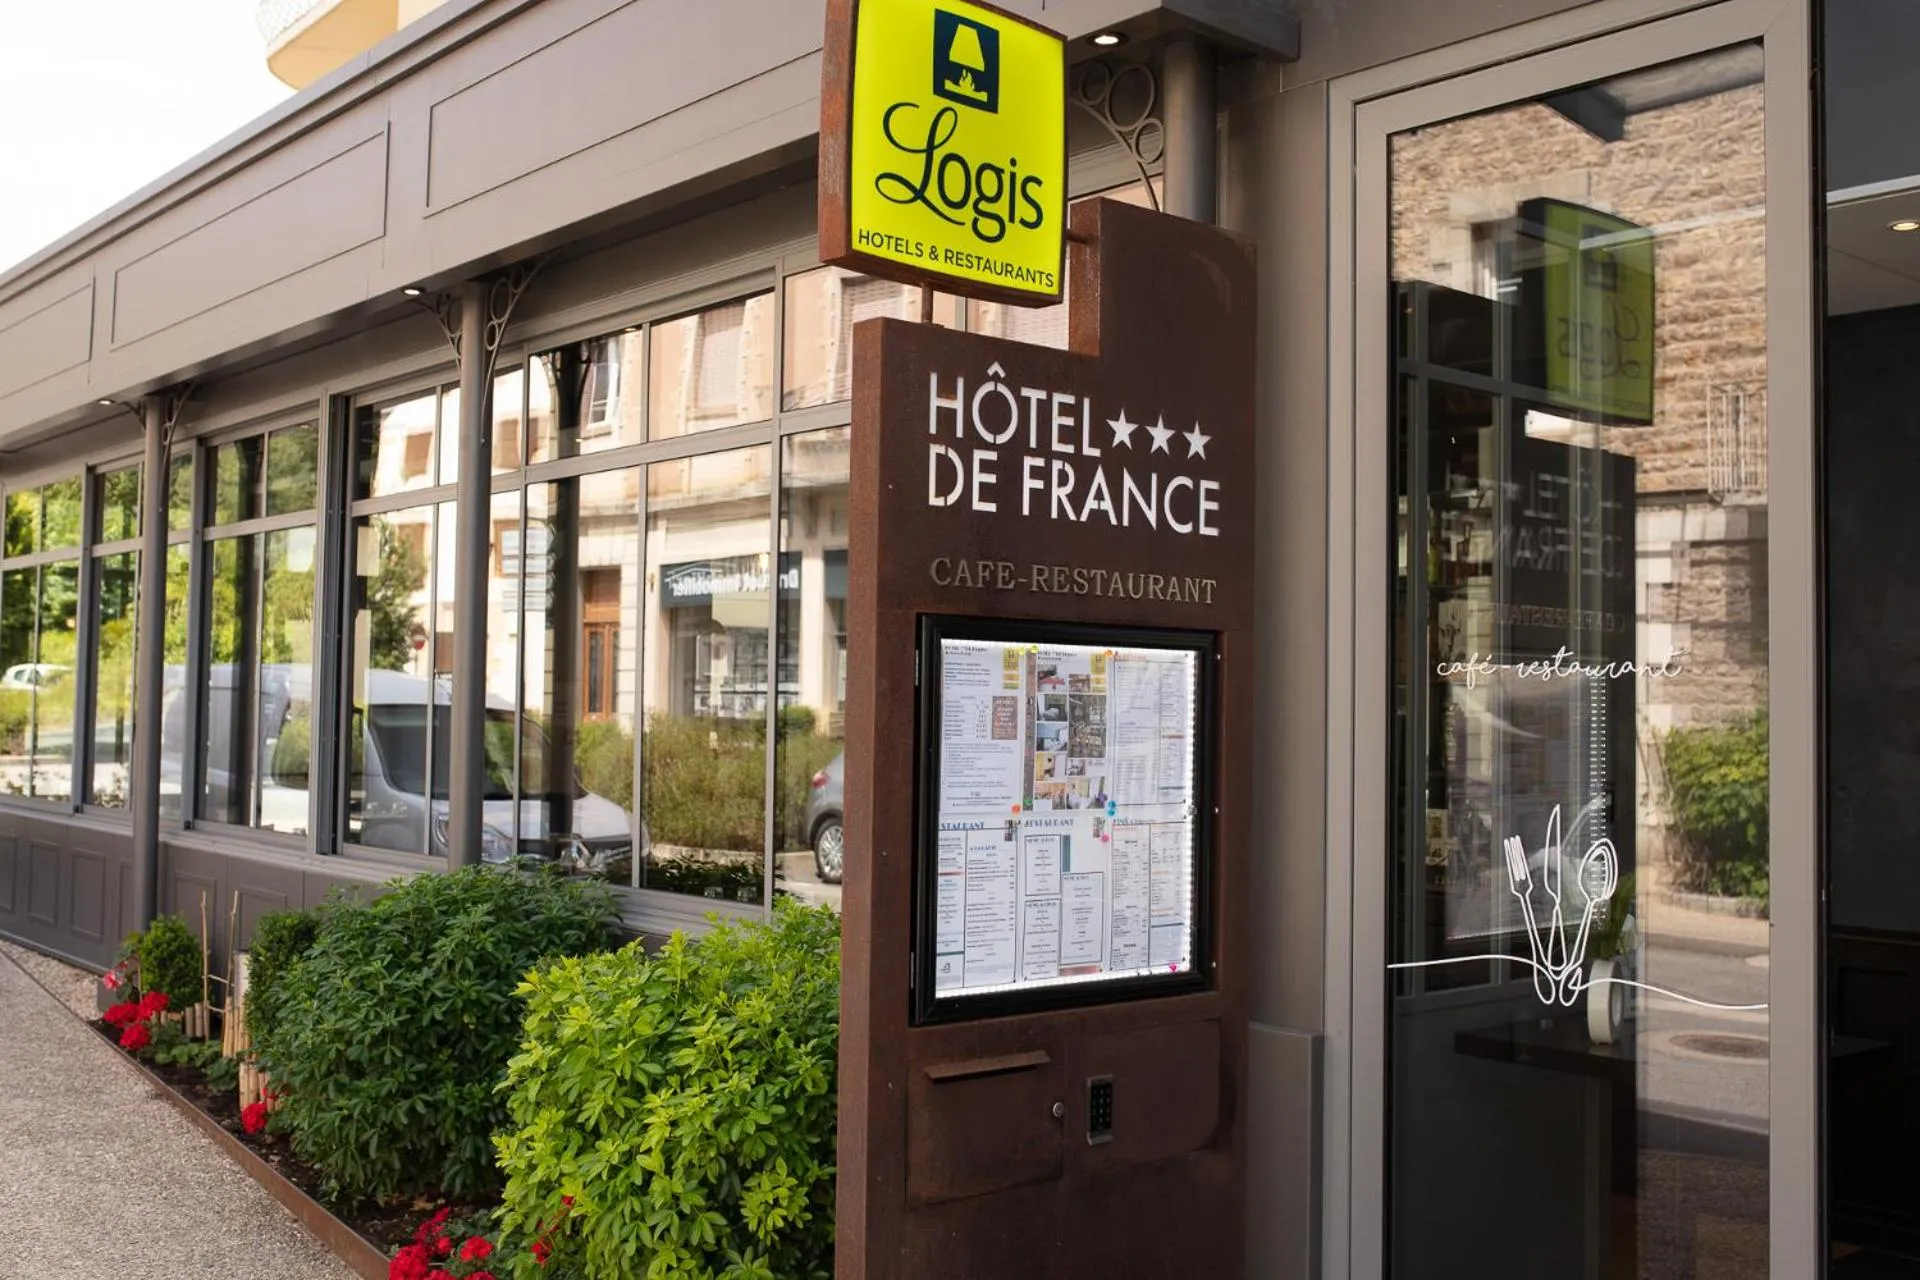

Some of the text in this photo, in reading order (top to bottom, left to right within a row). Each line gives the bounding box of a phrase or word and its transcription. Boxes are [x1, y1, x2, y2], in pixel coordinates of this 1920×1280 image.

[875, 101, 1044, 244] Logis
[858, 229, 1055, 289] HOTELS & RESTAURANTS
[929, 361, 1100, 458] HÔTEL
[928, 444, 1220, 537] DE FRANCE
[930, 557, 1217, 605] CAFE-RESTAURANT
